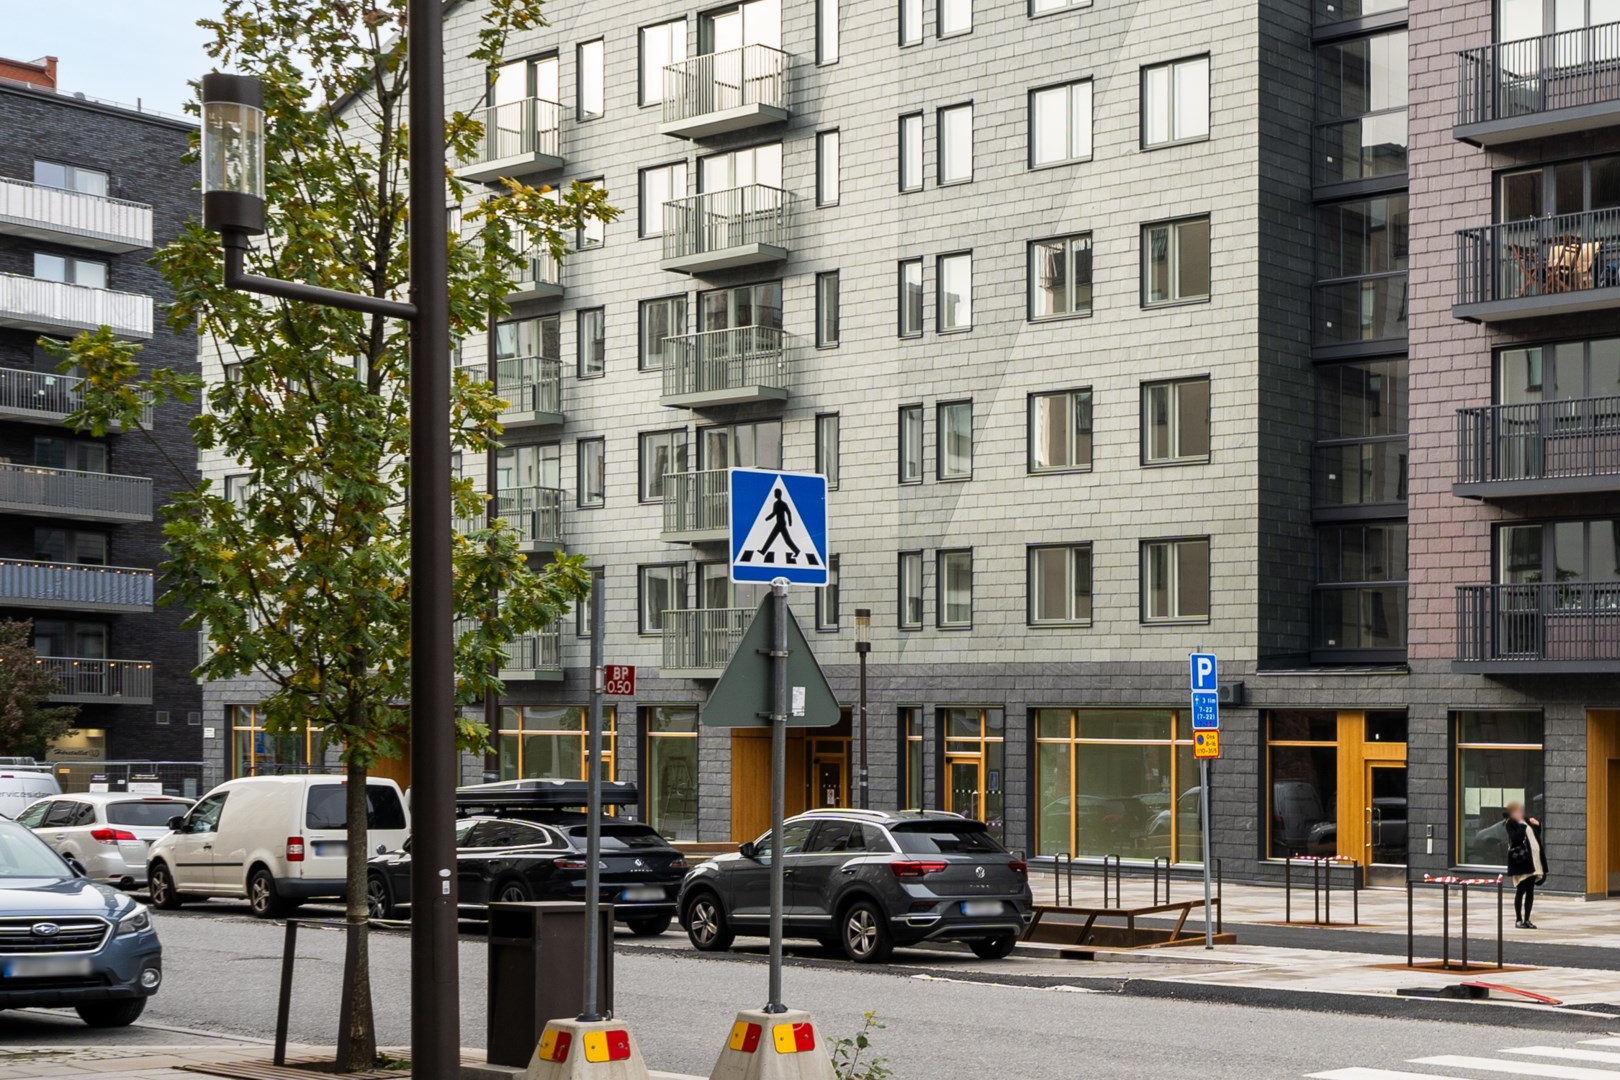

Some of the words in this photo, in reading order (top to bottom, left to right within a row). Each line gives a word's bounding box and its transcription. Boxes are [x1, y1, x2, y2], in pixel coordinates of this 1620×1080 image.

[613, 666, 629, 680] BP
[1197, 657, 1213, 688] P
[607, 680, 632, 694] 0.50
